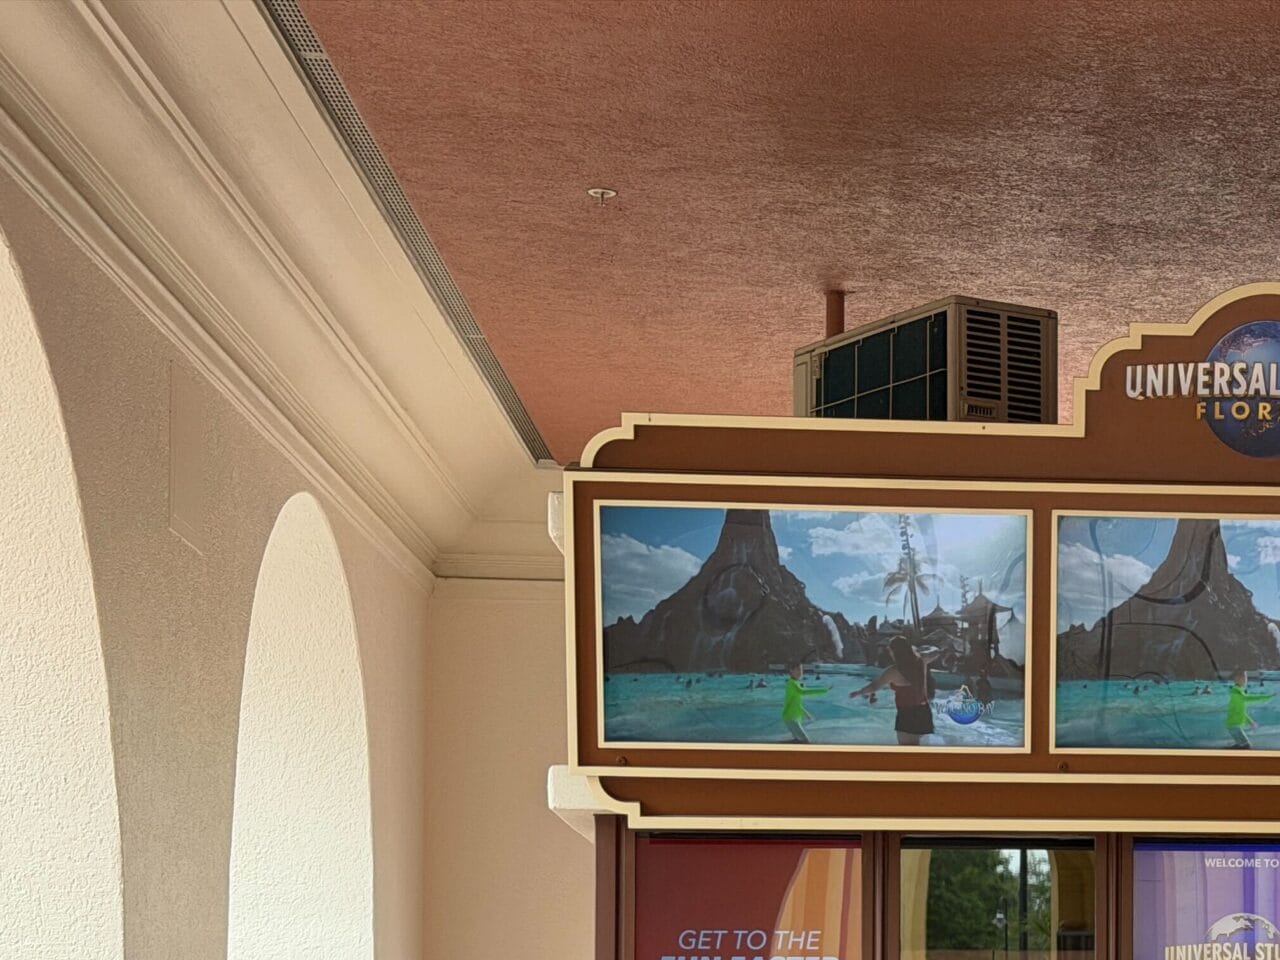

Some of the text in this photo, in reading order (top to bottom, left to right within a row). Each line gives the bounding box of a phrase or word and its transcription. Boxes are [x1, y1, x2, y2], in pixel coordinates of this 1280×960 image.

[1204, 857, 1280, 869] WELCOME TO
[677, 929, 823, 951] GET TO THE
